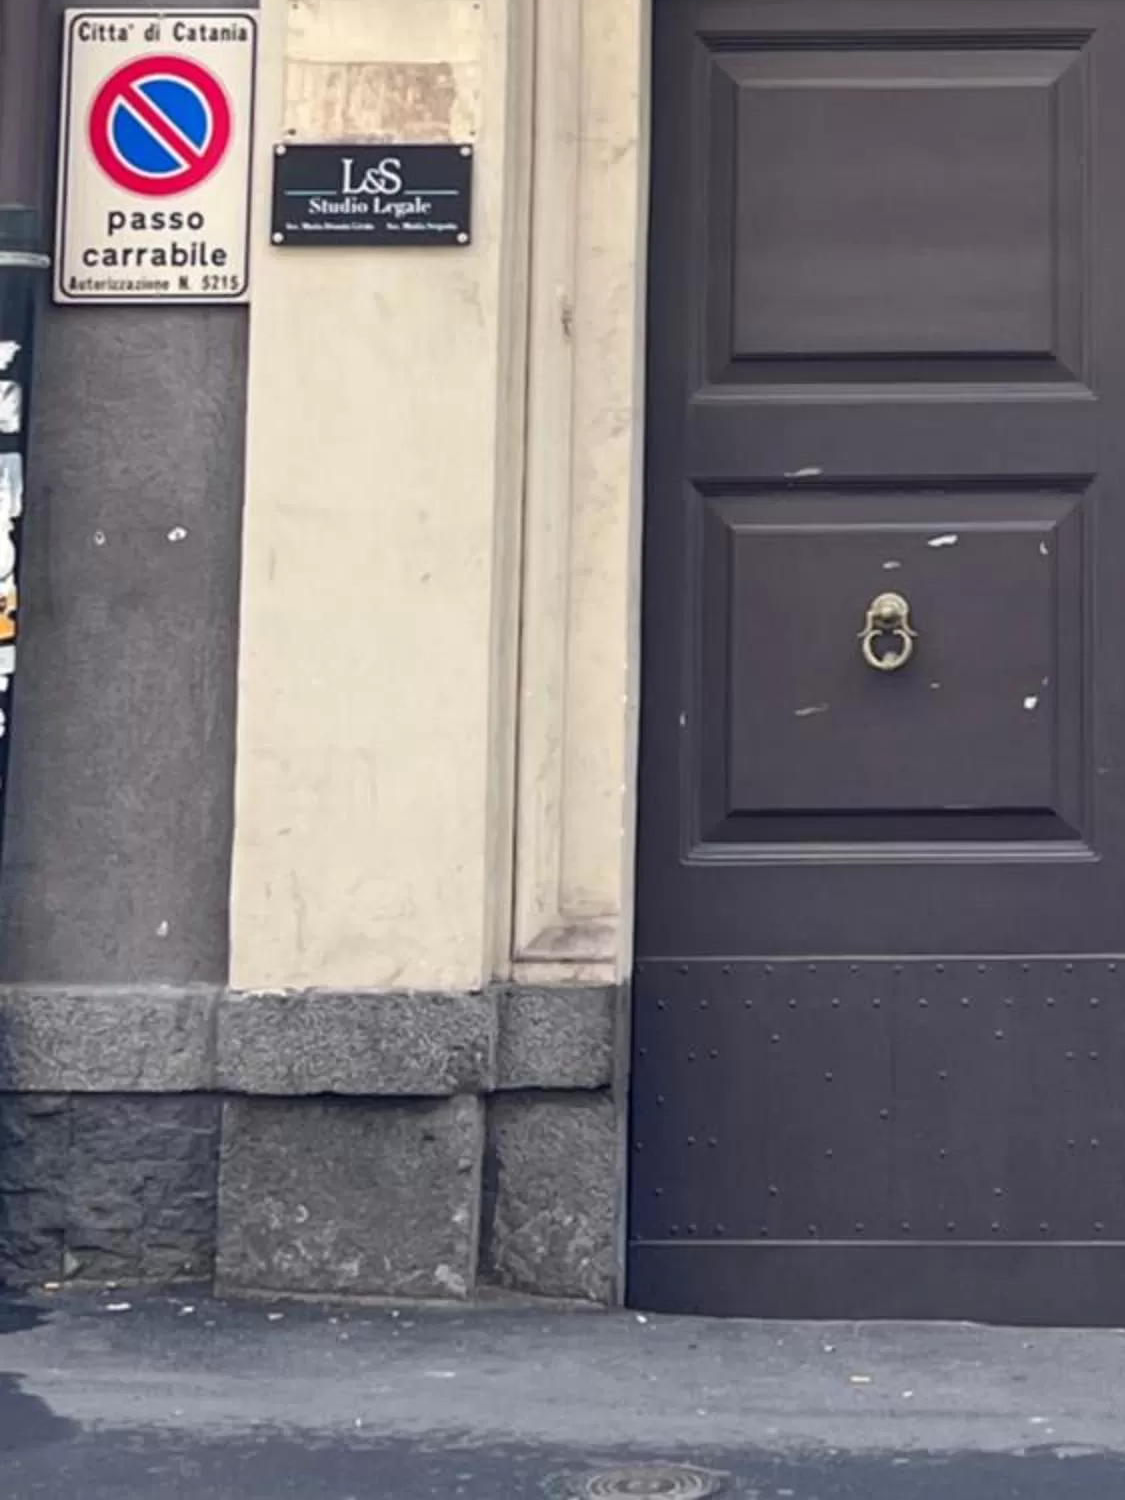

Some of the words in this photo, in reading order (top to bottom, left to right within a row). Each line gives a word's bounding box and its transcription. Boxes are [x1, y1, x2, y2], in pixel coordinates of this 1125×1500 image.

[144, 22, 161, 41] di
[173, 22, 248, 42] Catania
[341, 157, 402, 195] L&S
[308, 197, 368, 214] Studio
[373, 197, 431, 218] Legale
[107, 210, 205, 236] passo
[82, 242, 227, 268] carrabile
[202, 275, 240, 291] 5215
